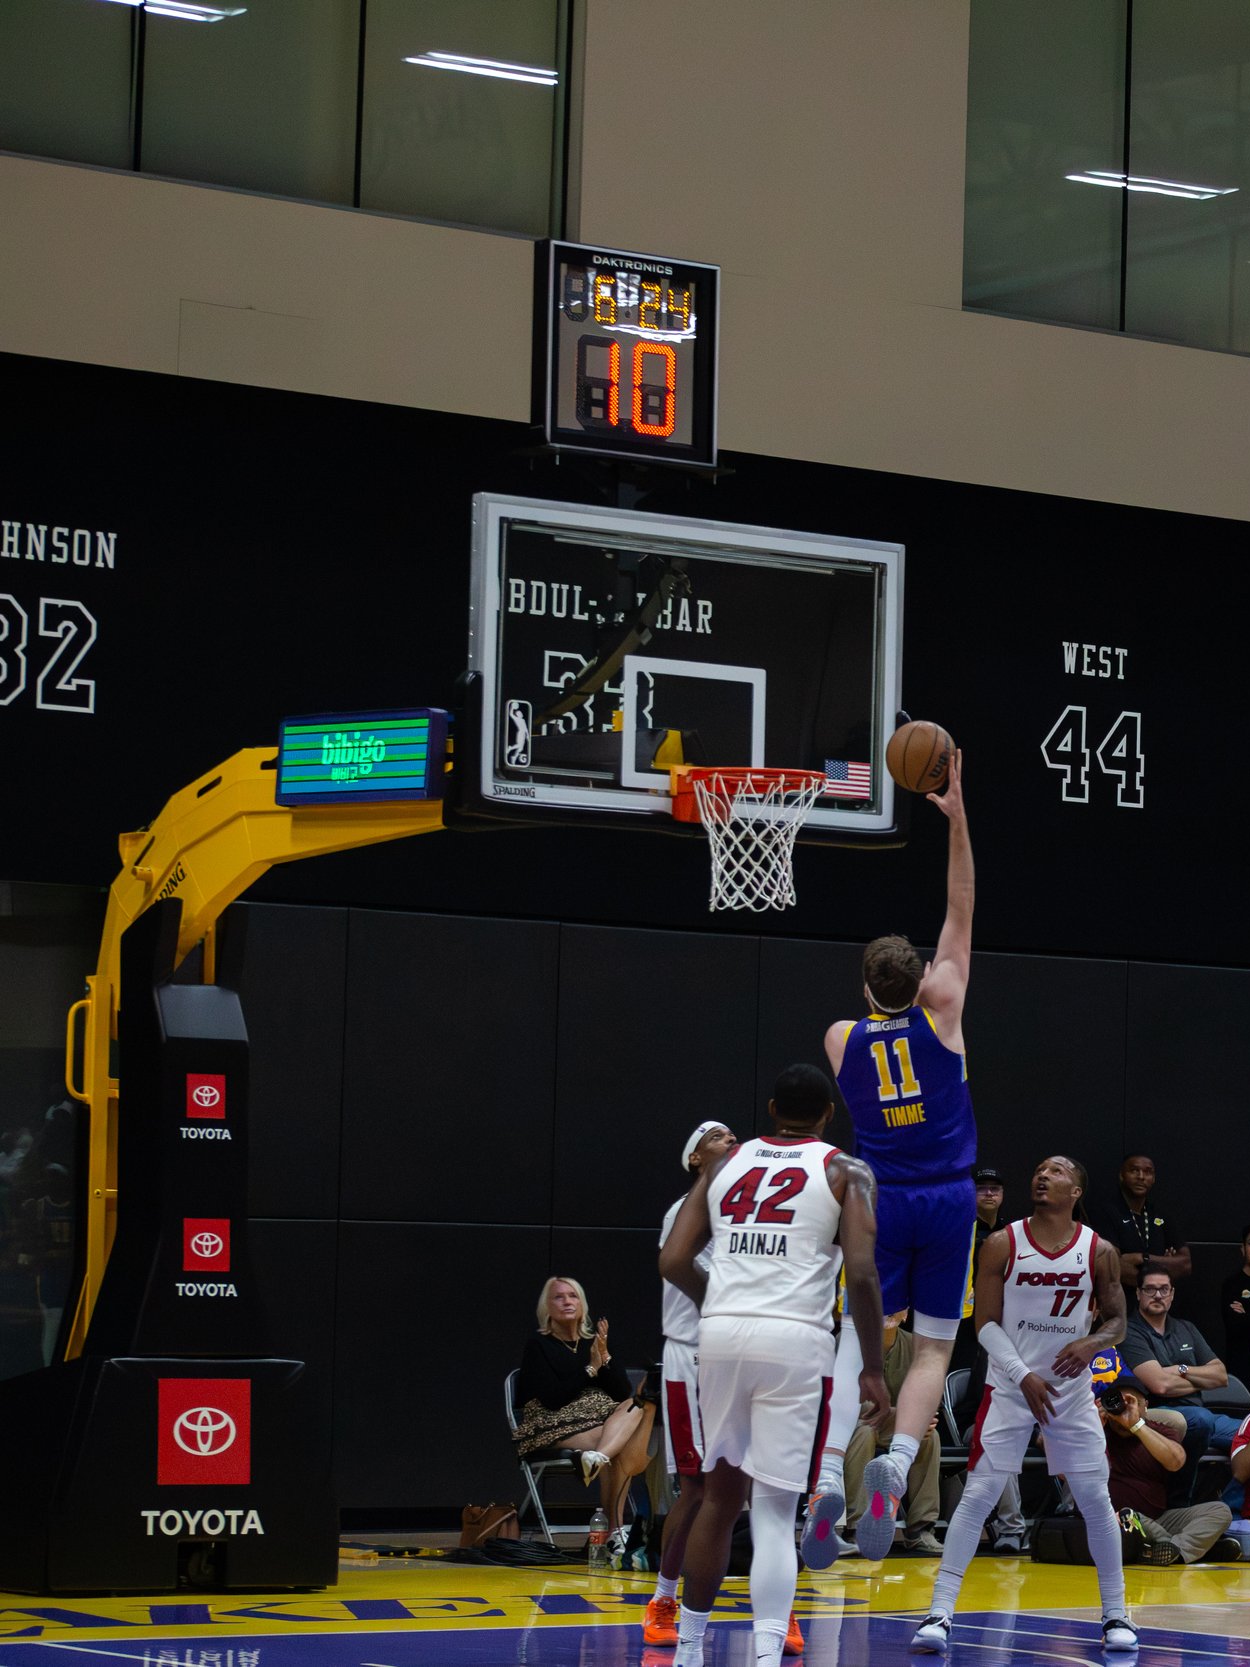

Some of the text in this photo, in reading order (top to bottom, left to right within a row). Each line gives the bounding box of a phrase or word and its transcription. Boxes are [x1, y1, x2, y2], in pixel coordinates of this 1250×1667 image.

[592, 254, 674, 276] DAKTRONICS
[607, 341, 676, 437] 10
[1062, 641, 1128, 680] WEST
[321, 731, 387, 775] bibigo
[1040, 704, 1145, 809] 44
[493, 784, 536, 799] SPALDING
[870, 1037, 922, 1102] 11
[881, 1102, 927, 1128] TIMME
[179, 1127, 233, 1141] TOYOTA
[720, 1167, 809, 1225] 42
[729, 1232, 787, 1257] DAINJA
[175, 1281, 239, 1298] TOYOTA
[1016, 1268, 1086, 1287] FORCE
[1050, 1289, 1085, 1318] 17
[1027, 1322, 1077, 1334] Robinhood
[141, 1509, 265, 1536] TOYOTA
